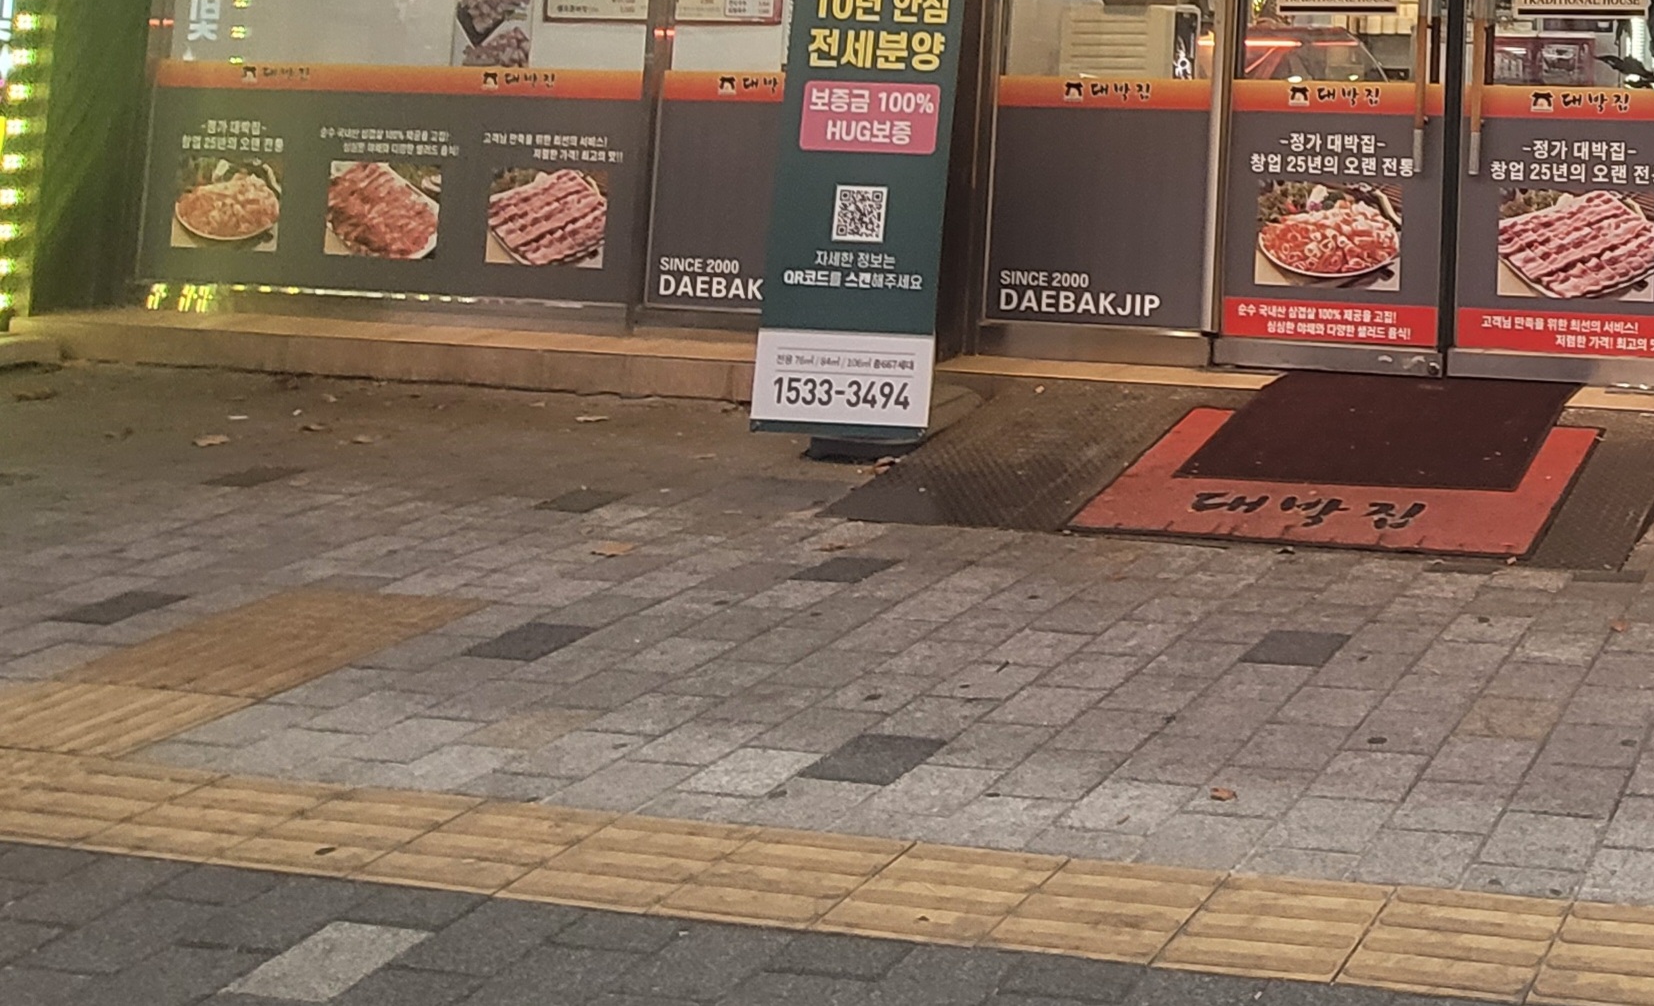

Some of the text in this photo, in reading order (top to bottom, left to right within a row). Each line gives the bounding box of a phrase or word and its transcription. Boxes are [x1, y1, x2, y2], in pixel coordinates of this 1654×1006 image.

[808, 27, 945, 72] 전세분양
[809, 87, 934, 113] 보증금 100%
[1090, 82, 1151, 101] 대박집
[1316, 86, 1381, 106] 대박집
[1561, 92, 1631, 112] 대박집
[826, 119, 912, 145] HUG보증
[1279, 132, 1387, 154] -정가 대박집-
[1522, 140, 1637, 161] -정가 대박집-
[1250, 153, 1415, 177] 창업 25년의 오랜 전통
[1490, 161, 1524, 181] 창업
[1529, 163, 1586, 183] 25년의
[1592, 164, 1627, 184] 오랜
[659, 257, 740, 274] SINCE 2000
[814, 250, 896, 269] 자세한 정보는
[784, 270, 923, 290] QR코드를 스캔해주세요
[1000, 270, 1089, 288] SINCE 2000
[999, 288, 1161, 317] DAEBAKJIP
[1481, 315, 1638, 334] 고객님 만족을 위한 최선의 서비스!
[1555, 334, 1586, 348] 저렴한
[1589, 335, 1613, 350] 가격!
[1616, 337, 1647, 351] 최고의
[774, 376, 910, 411] 1533-3494
[1190, 491, 1428, 530] 대박집
